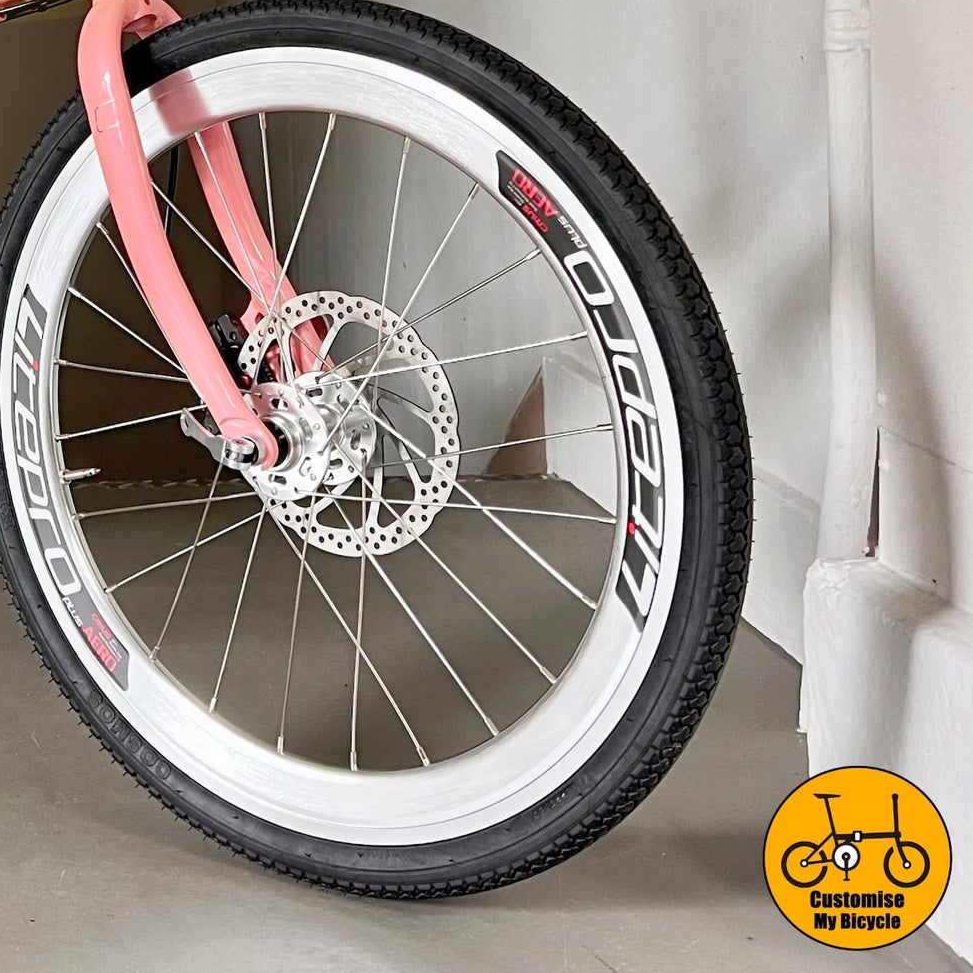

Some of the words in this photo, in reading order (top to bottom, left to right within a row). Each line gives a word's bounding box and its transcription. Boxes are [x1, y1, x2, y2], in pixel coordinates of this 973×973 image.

[512, 169, 560, 217] AERO
[13, 297, 81, 596] Litepro
[82, 625, 117, 672] AERO
[563, 250, 663, 618] Litepro
